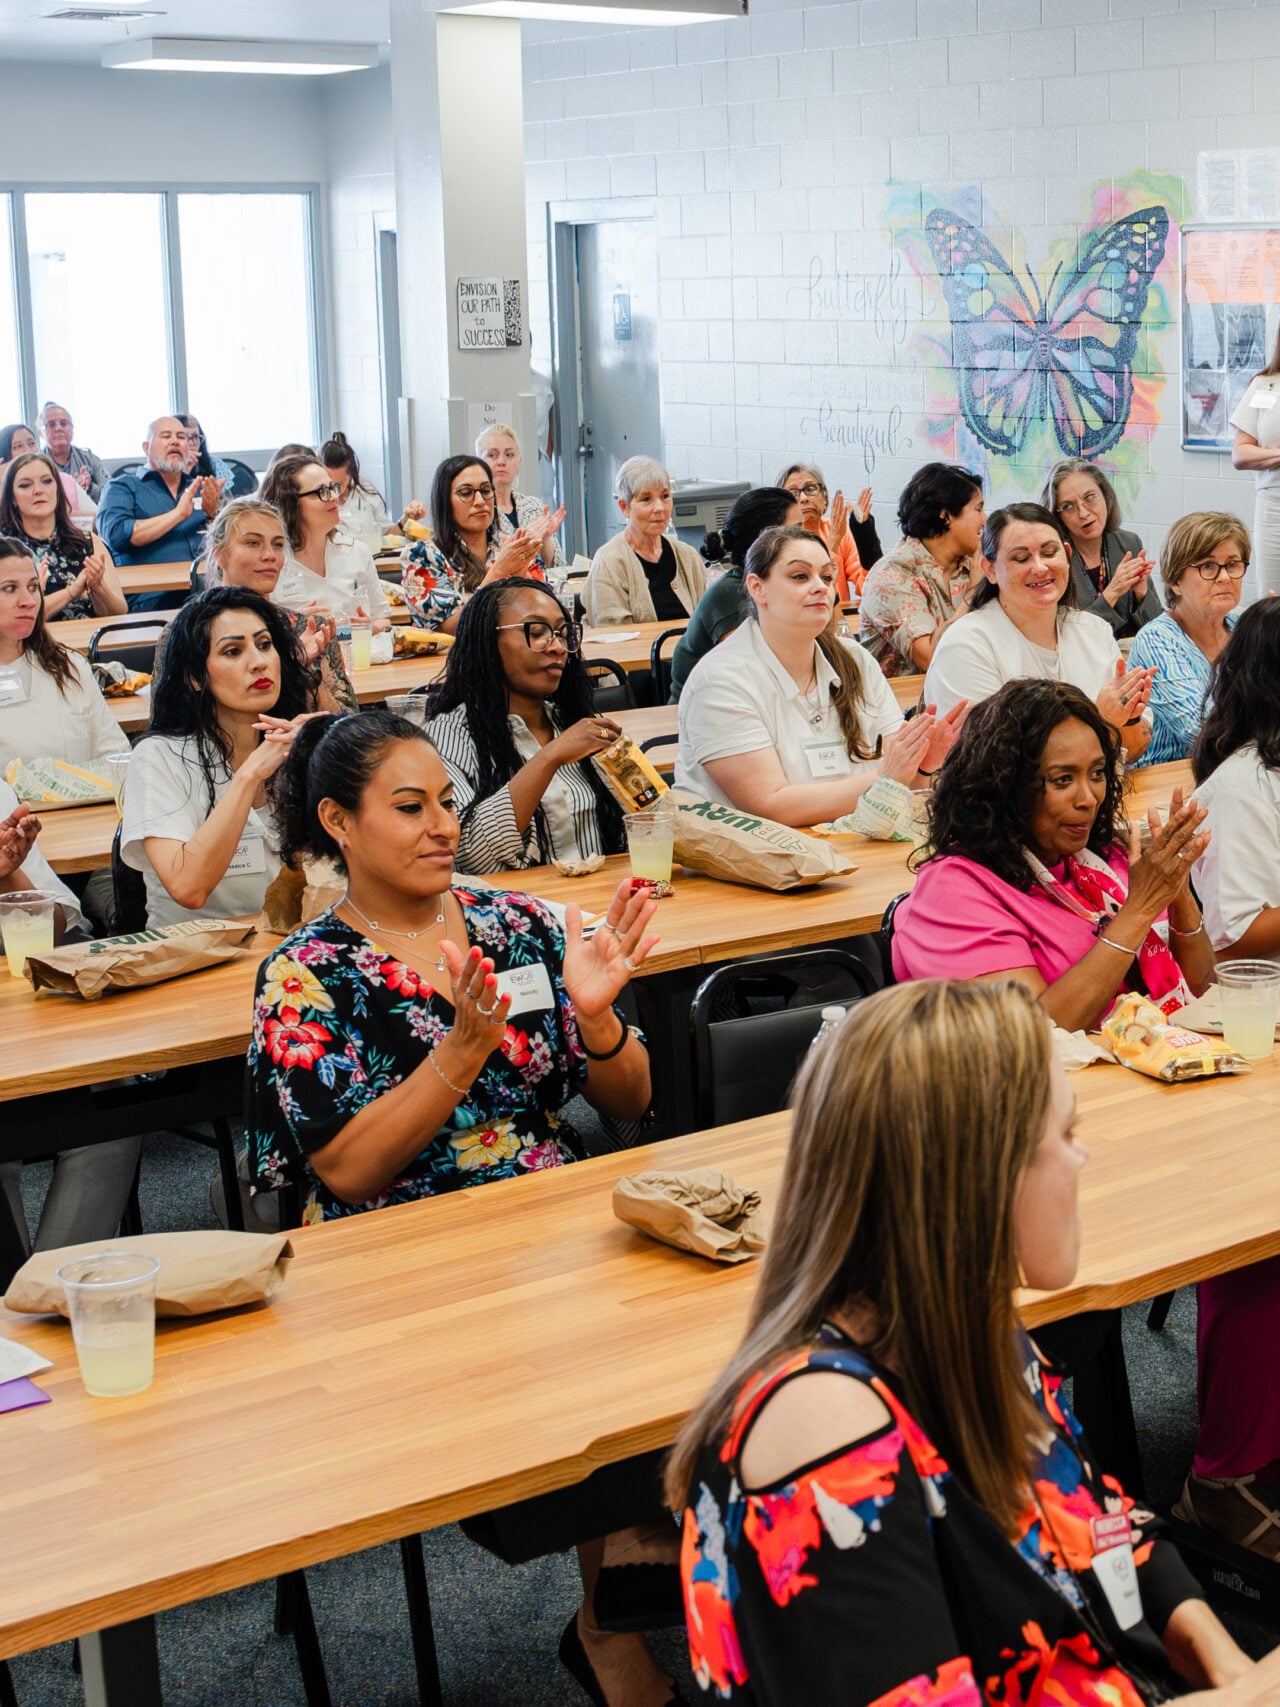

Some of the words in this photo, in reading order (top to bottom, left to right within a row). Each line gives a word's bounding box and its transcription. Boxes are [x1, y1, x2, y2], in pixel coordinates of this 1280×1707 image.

[460, 282, 498, 297] ENVISION
[461, 299, 479, 313] OUR
[481, 298, 501, 313] PATH
[473, 317, 485, 326] to
[464, 328, 507, 346] SUCCESS
[484, 403, 495, 412] Do
